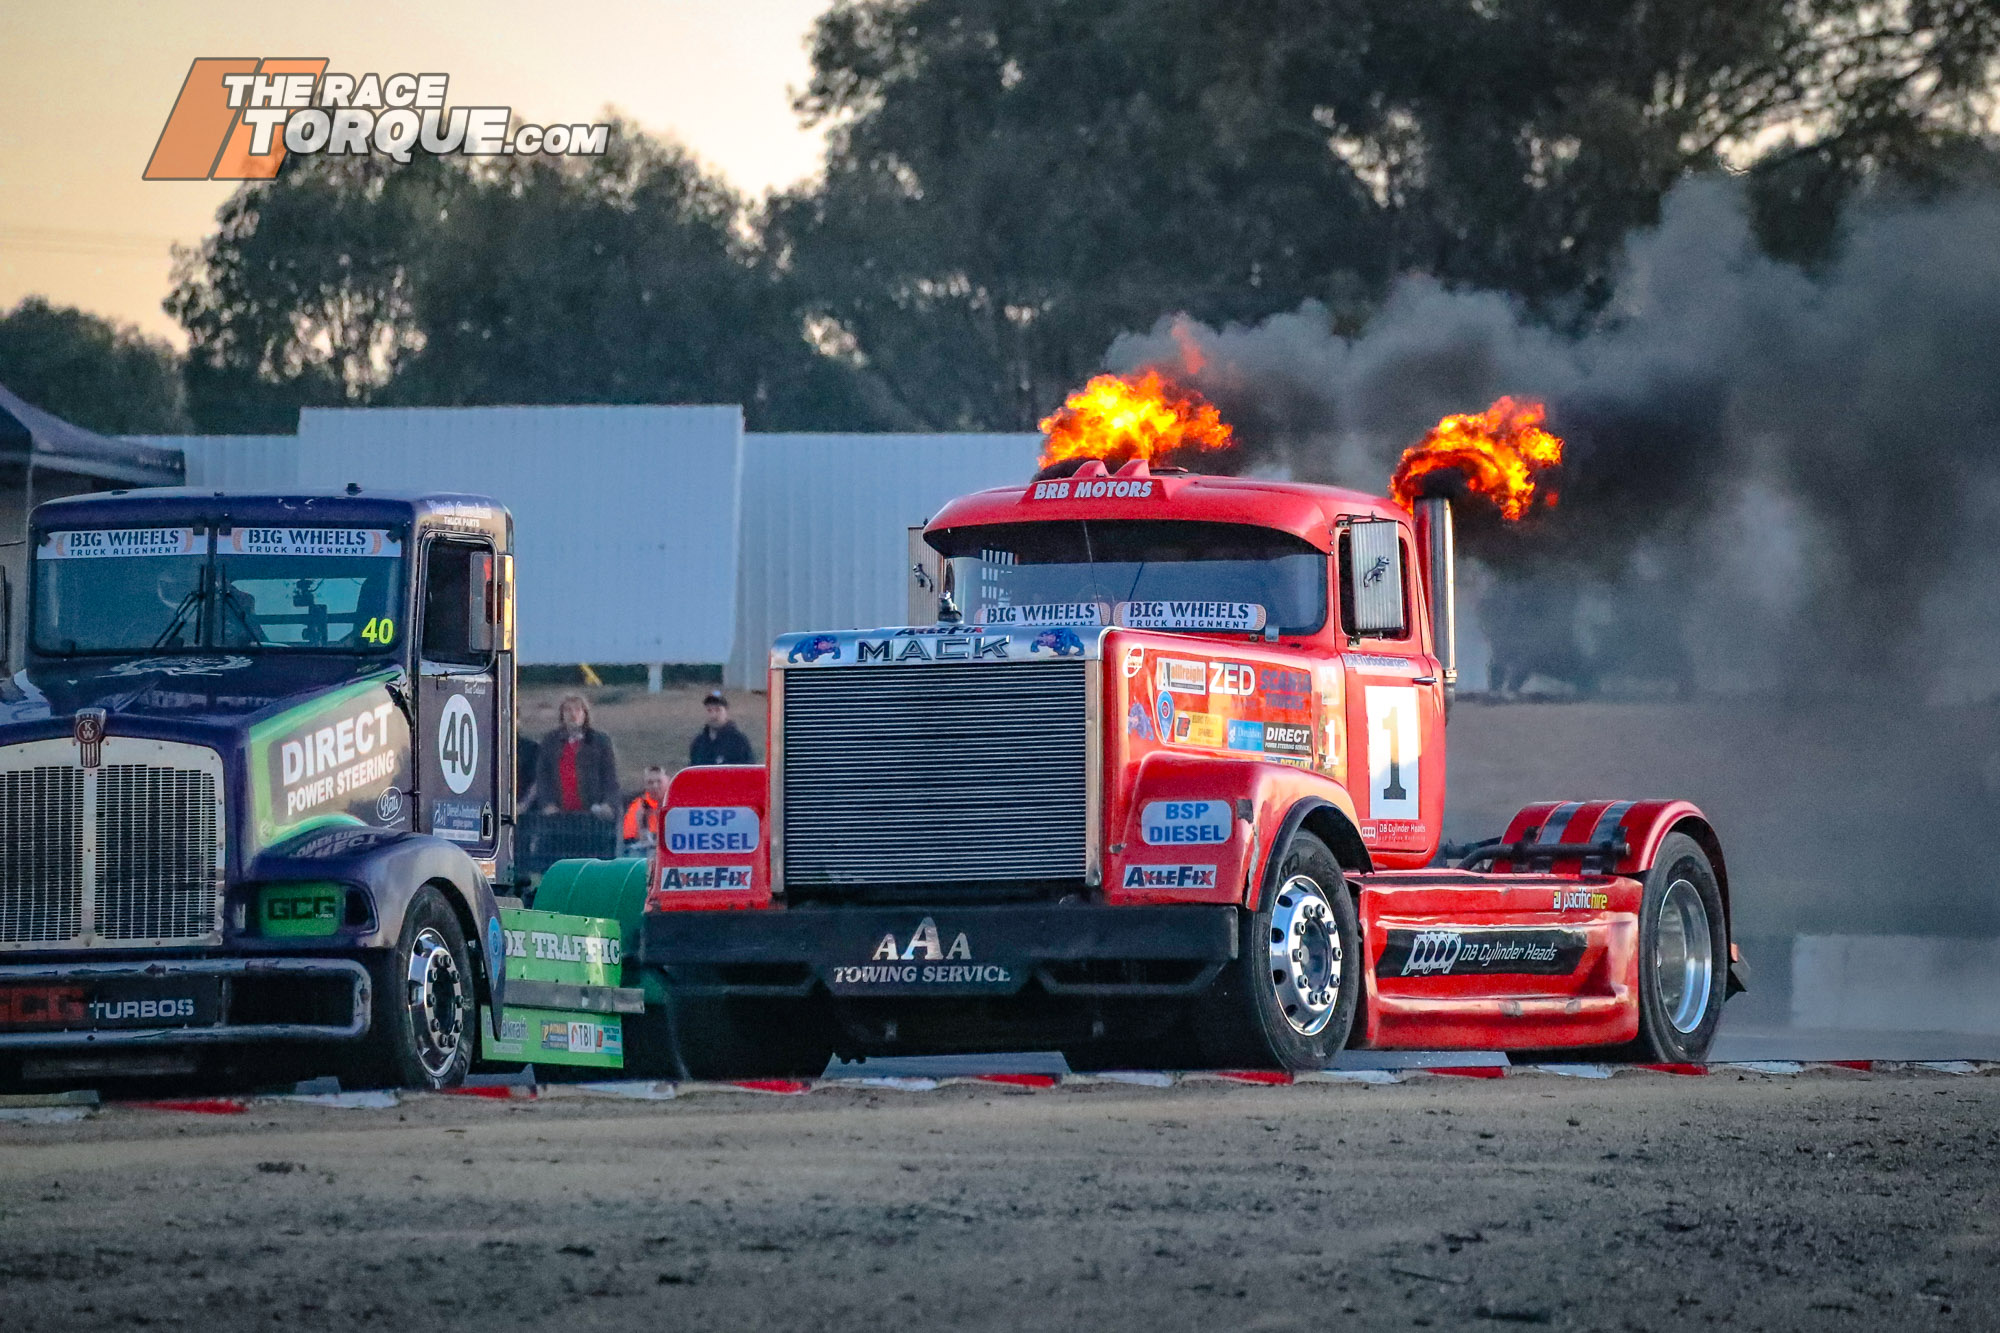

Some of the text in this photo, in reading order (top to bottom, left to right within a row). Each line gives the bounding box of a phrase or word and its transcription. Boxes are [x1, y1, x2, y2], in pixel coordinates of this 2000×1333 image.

[1034, 481, 1153, 499] BRB MOTORS
[70, 530, 179, 547] BIG WHEELS
[248, 529, 366, 545] BIG WHEELS
[70, 546, 179, 556] TRUCK ALIGNMENT
[248, 545, 366, 555] TRUCK ALIGNMENT
[987, 604, 1095, 623] BIG WHEELS
[1129, 602, 1249, 619] BIG WHEELS
[361, 617, 394, 644] 40
[1129, 619, 1248, 629] TRUCK ALIGNMENT
[857, 635, 1010, 662] MACK
[1208, 661, 1256, 696] ZED
[282, 701, 393, 787] DIRECT
[443, 711, 473, 777] 40
[1266, 727, 1310, 743] DIRECT
[1382, 706, 1407, 801] 1
[287, 749, 395, 817] POWER STEERING
[688, 810, 737, 826] BSP
[1165, 803, 1210, 820] BSP
[672, 833, 754, 850] DIESEL
[1149, 825, 1225, 842] DIESEL
[267, 896, 336, 921] GCG
[532, 931, 620, 965] TRAFFIC
[1460, 940, 1558, 966] DB Cylinder Heads
[833, 965, 1011, 983] TOWING SERVICE
[89, 998, 195, 1020] TURBOS
[578, 1024, 592, 1046] TBI
